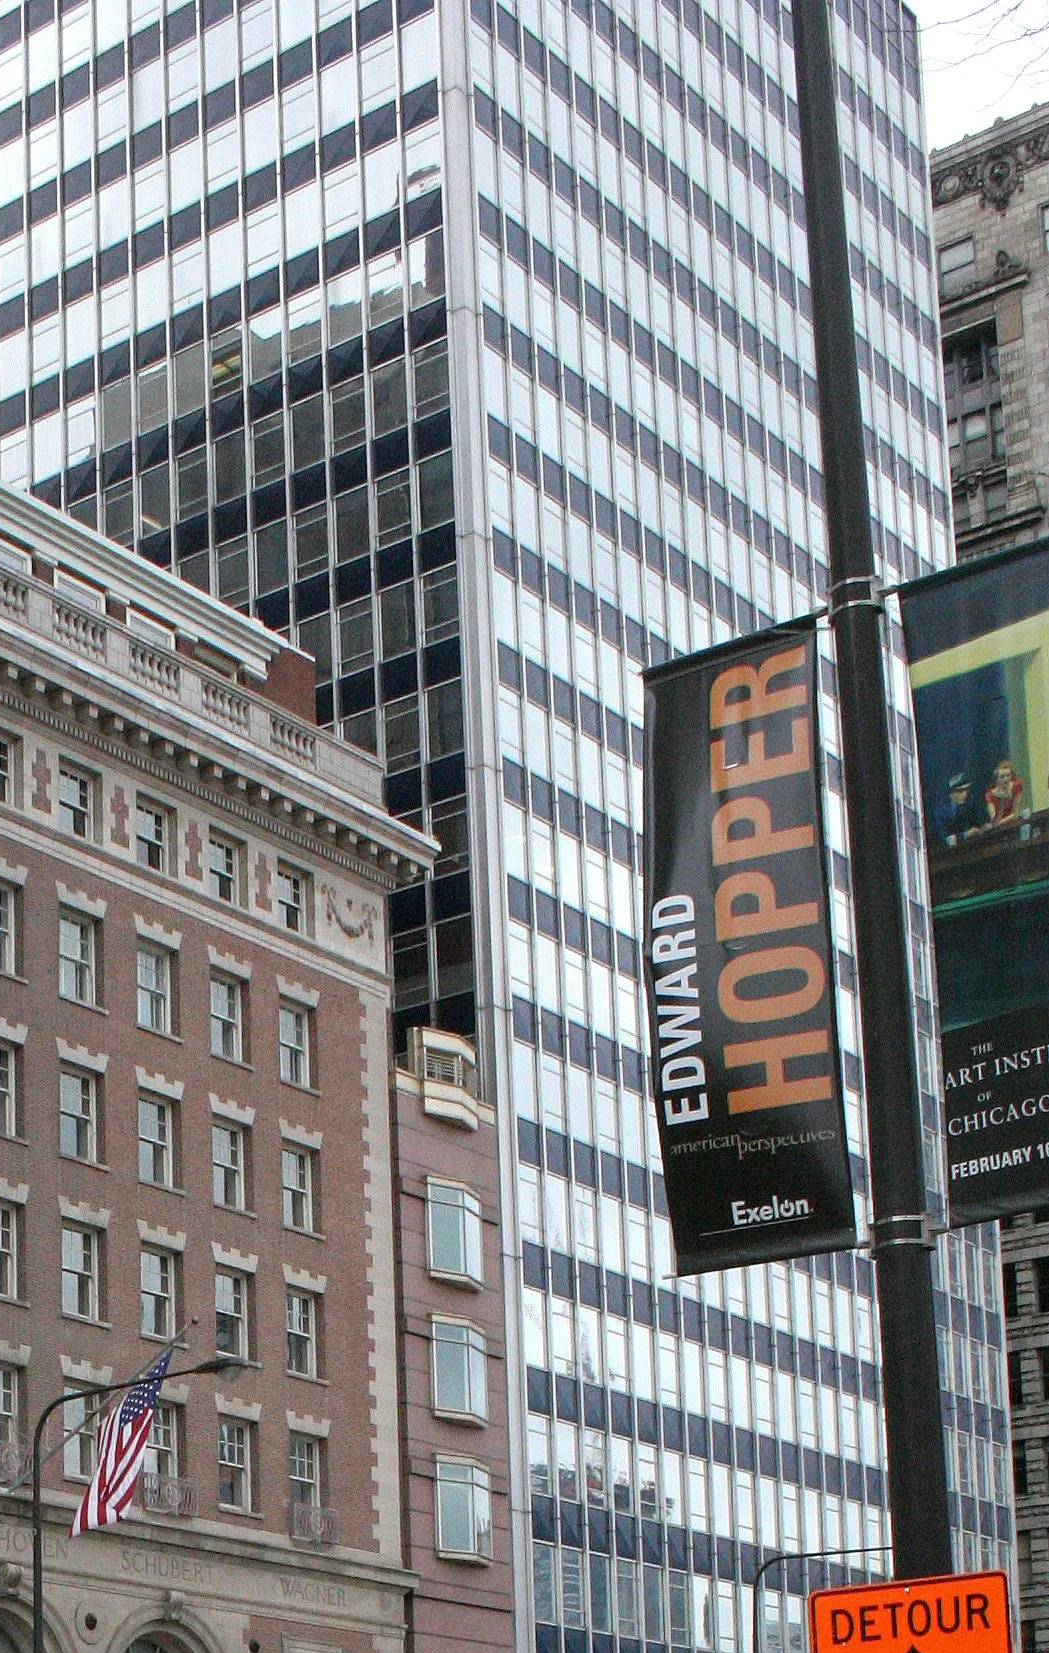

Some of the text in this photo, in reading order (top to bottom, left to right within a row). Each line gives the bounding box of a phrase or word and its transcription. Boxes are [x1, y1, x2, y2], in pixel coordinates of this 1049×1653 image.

[710, 645, 833, 1114] HOPPER
[652, 893, 710, 1126] EDWARD
[971, 1042, 993, 1056] THE
[945, 1062, 986, 1090] ART
[977, 1090, 992, 1103] OF
[670, 1133, 740, 1156] american
[951, 1145, 1032, 1180] FEBRUARY
[730, 1195, 809, 1226] Exelon
[830, 1593, 991, 1645] DETOUR
